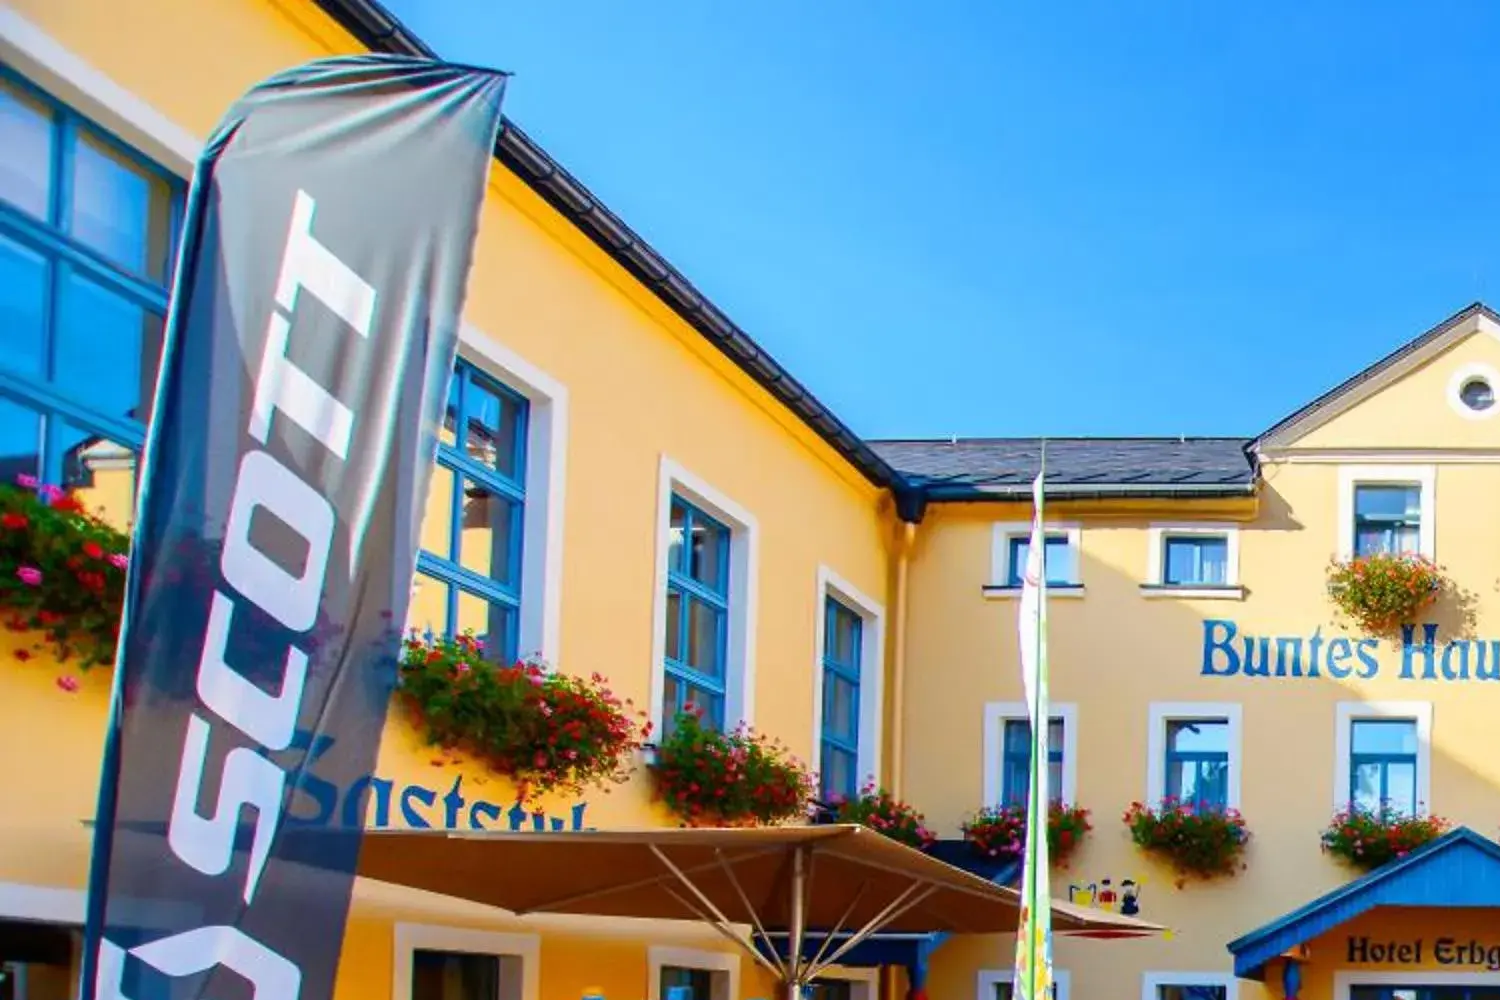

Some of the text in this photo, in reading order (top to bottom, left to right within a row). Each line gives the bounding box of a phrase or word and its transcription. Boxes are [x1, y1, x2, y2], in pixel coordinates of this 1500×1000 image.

[168, 188, 377, 905] SCOTT
[1200, 619, 1380, 679] Buntes
[1346, 935, 1422, 963] Hotel
